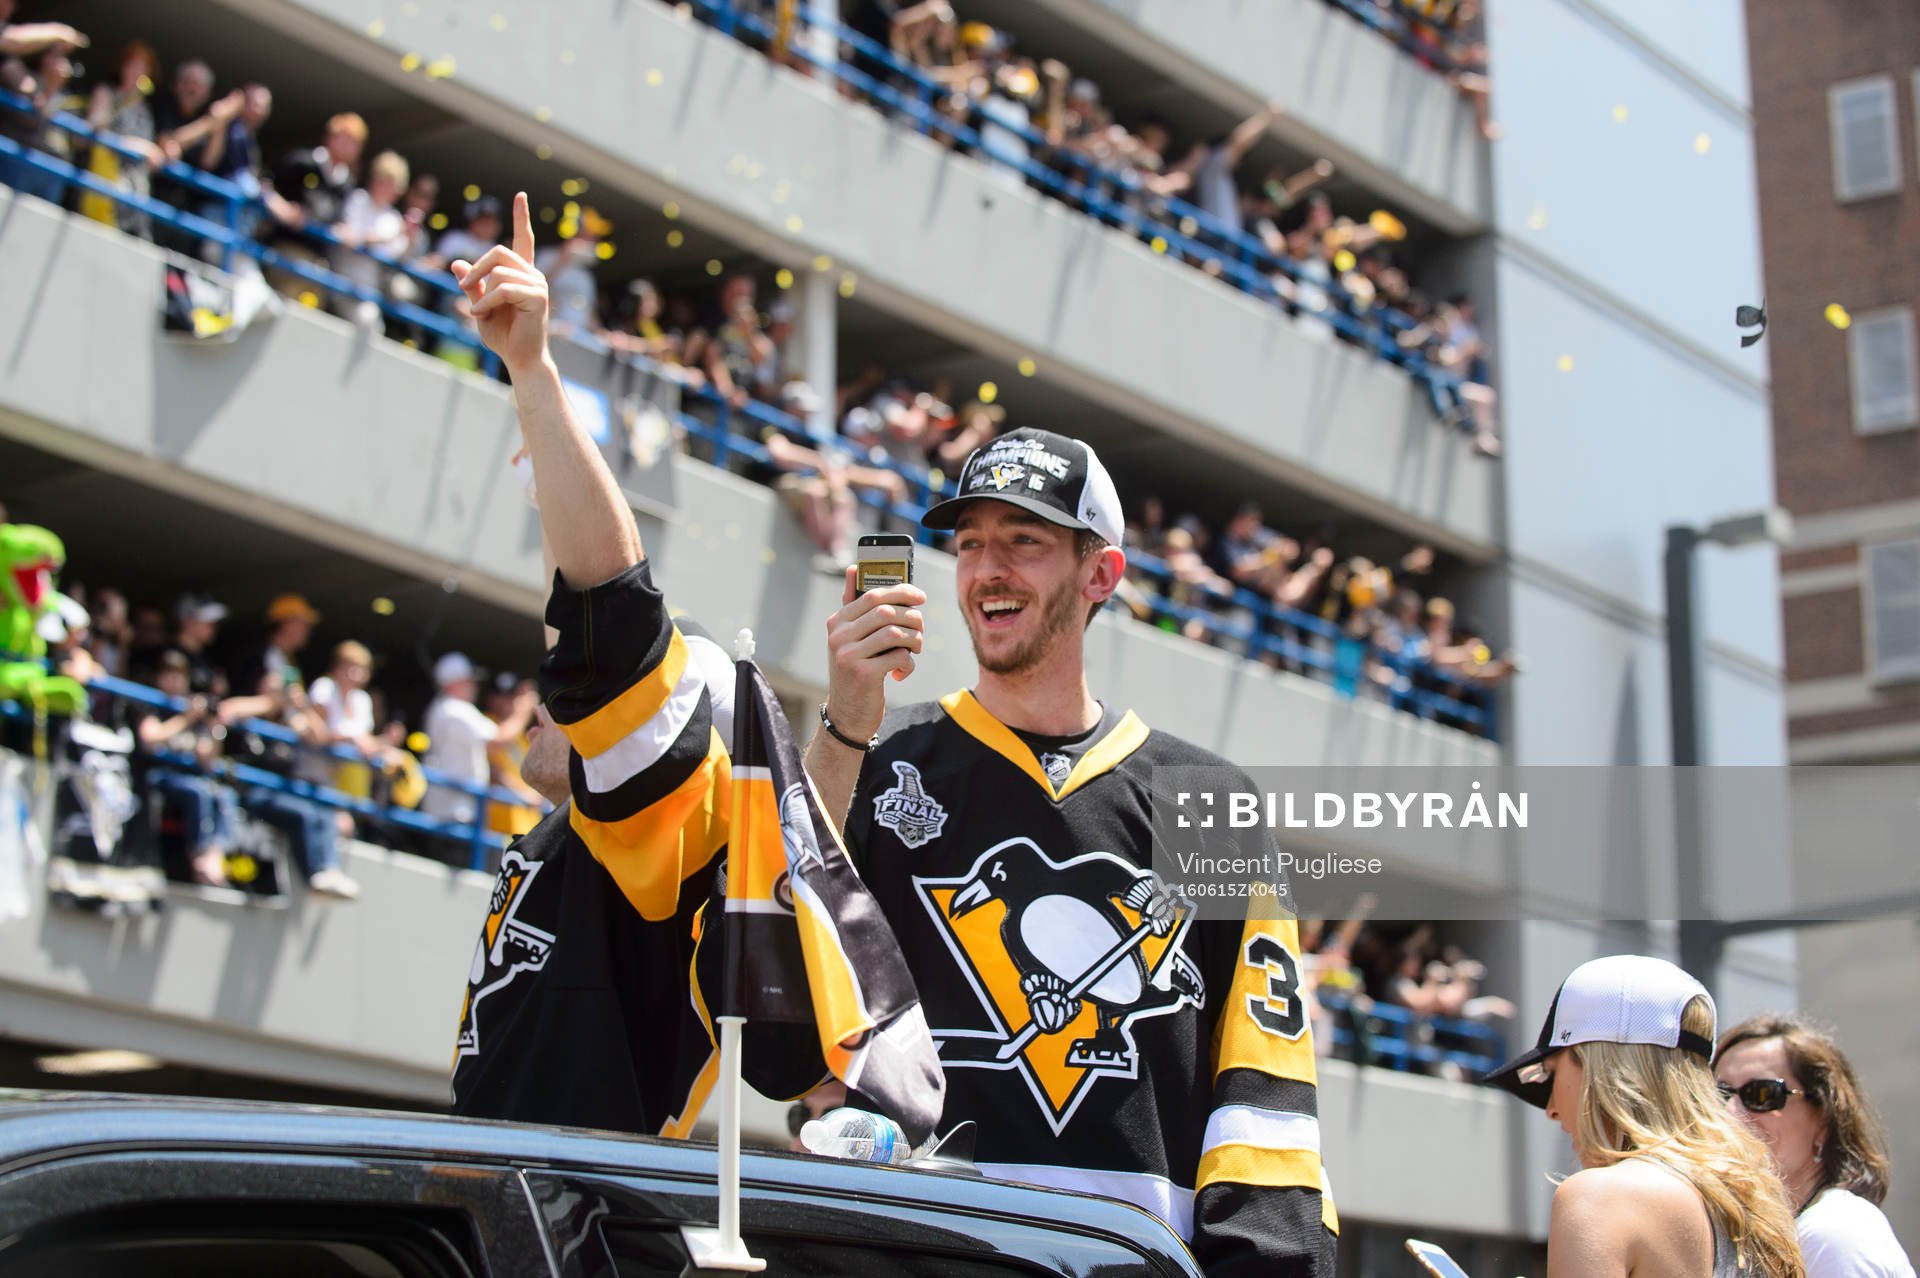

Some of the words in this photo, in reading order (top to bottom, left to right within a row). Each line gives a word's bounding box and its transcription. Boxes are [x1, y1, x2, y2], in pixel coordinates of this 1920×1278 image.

[967, 448, 1071, 481] CHAMPIONS
[1028, 473, 1046, 491] 16
[881, 799, 940, 821] FINAL
[1245, 932, 1307, 1040] 3
